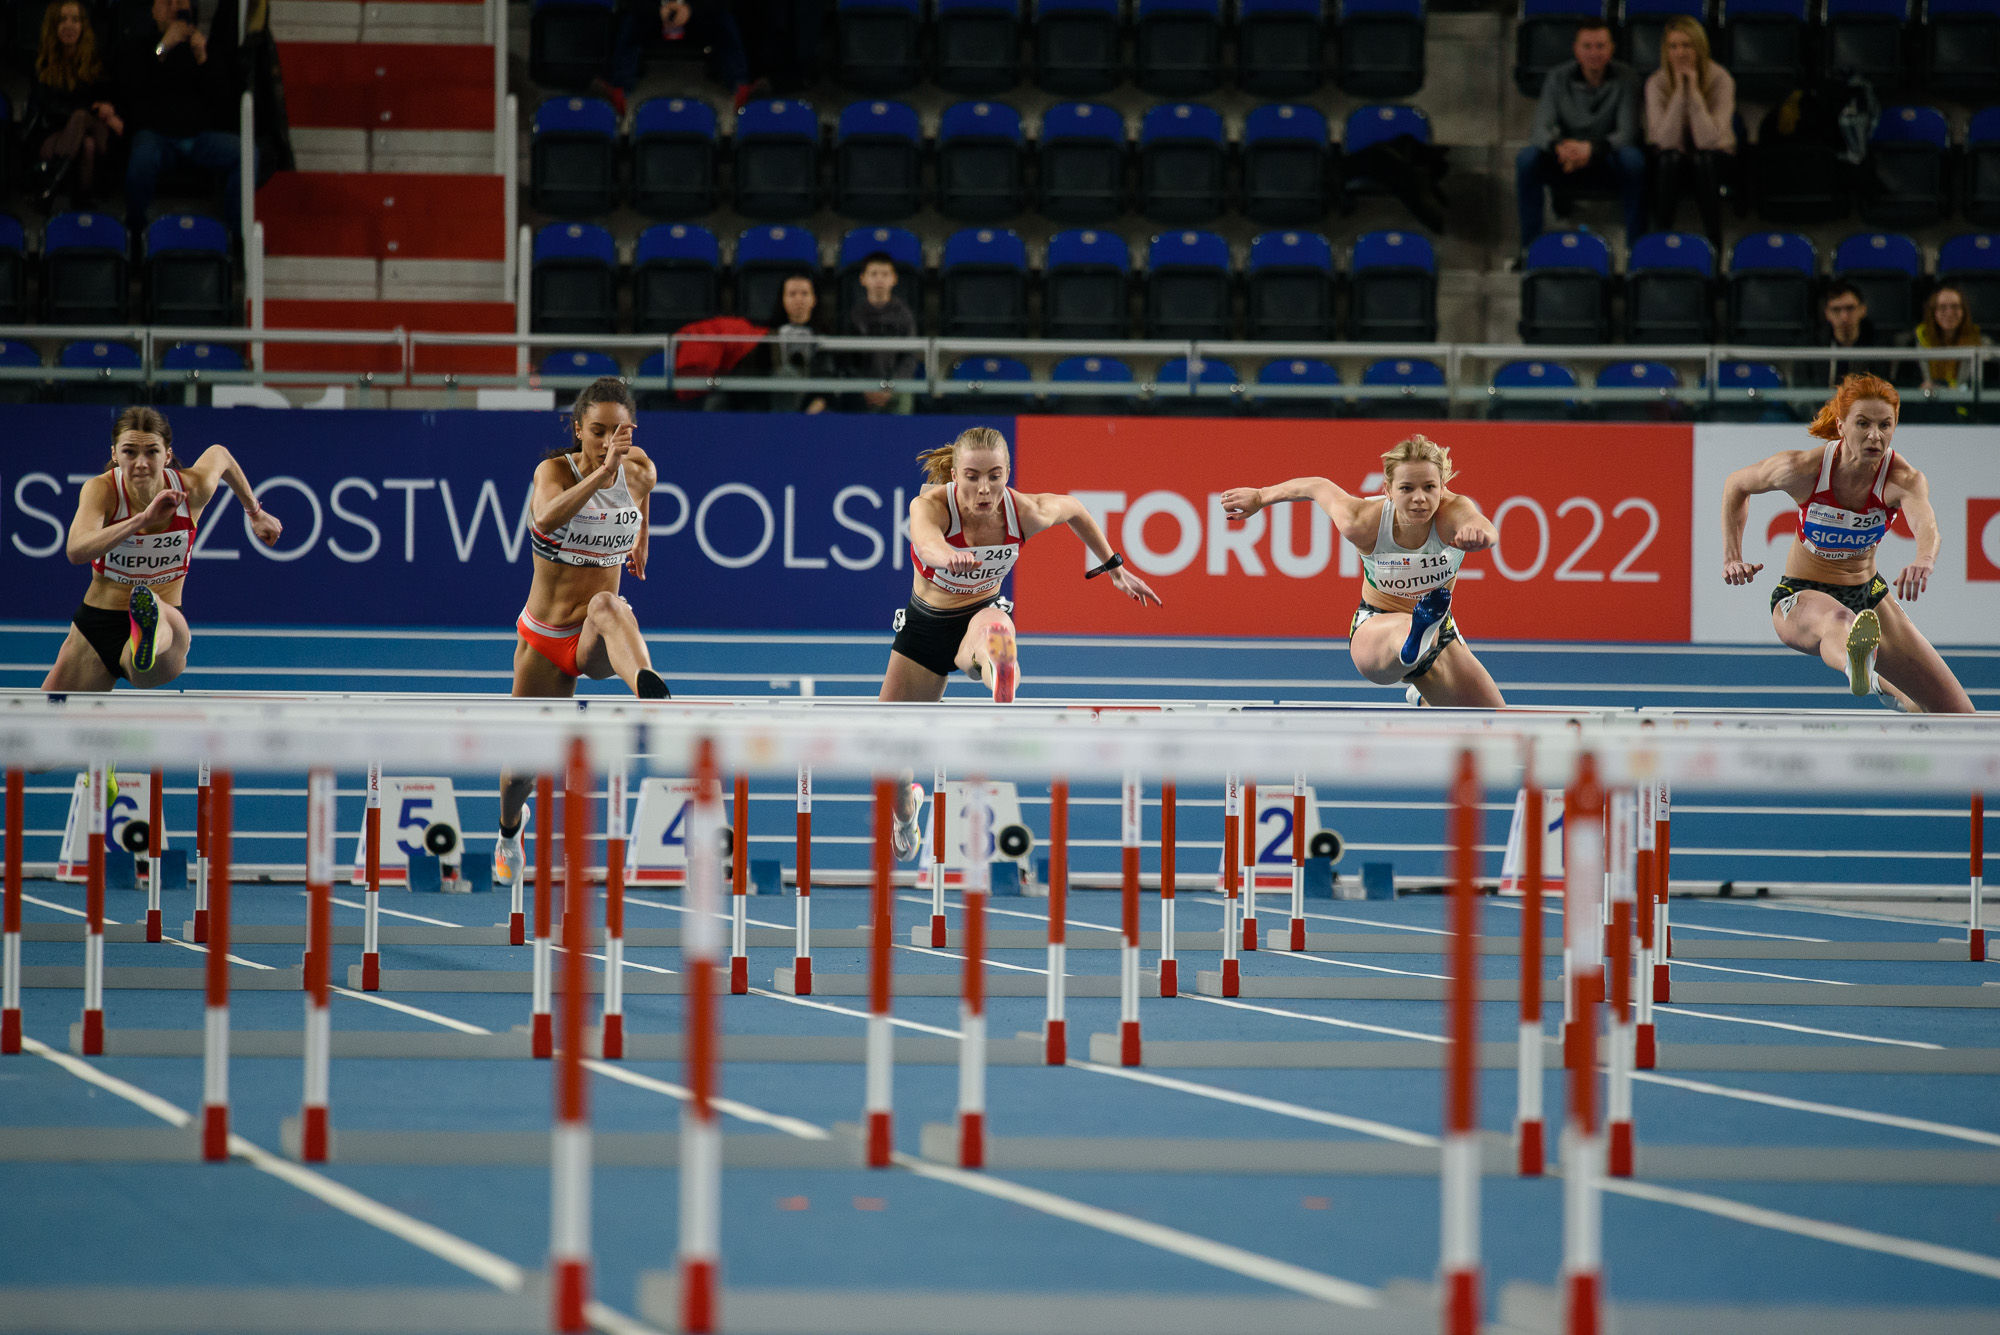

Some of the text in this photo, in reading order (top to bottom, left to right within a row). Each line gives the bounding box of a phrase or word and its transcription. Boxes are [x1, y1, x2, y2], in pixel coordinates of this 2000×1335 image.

[614, 511, 638, 525] 109
[1069, 473, 1384, 579] TORU
[1852, 514, 1881, 528] 250
[153, 534, 182, 549] 236
[567, 532, 635, 549] MAJEWSKA
[1811, 530, 1878, 545] SICIARZ
[109, 552, 182, 569] KIEPURA
[601, 556, 618, 566] 2022
[984, 548, 1012, 561] 249
[1420, 554, 1448, 569] 118
[117, 576, 172, 586] TORUŃ 2022
[1379, 566, 1453, 590] WOJTUNIK
[976, 581, 994, 593] 2022
[105, 796, 139, 853] 6
[397, 799, 432, 857] 5
[661, 799, 697, 858] 4
[960, 804, 995, 860] 3
[1258, 807, 1294, 864] 2
